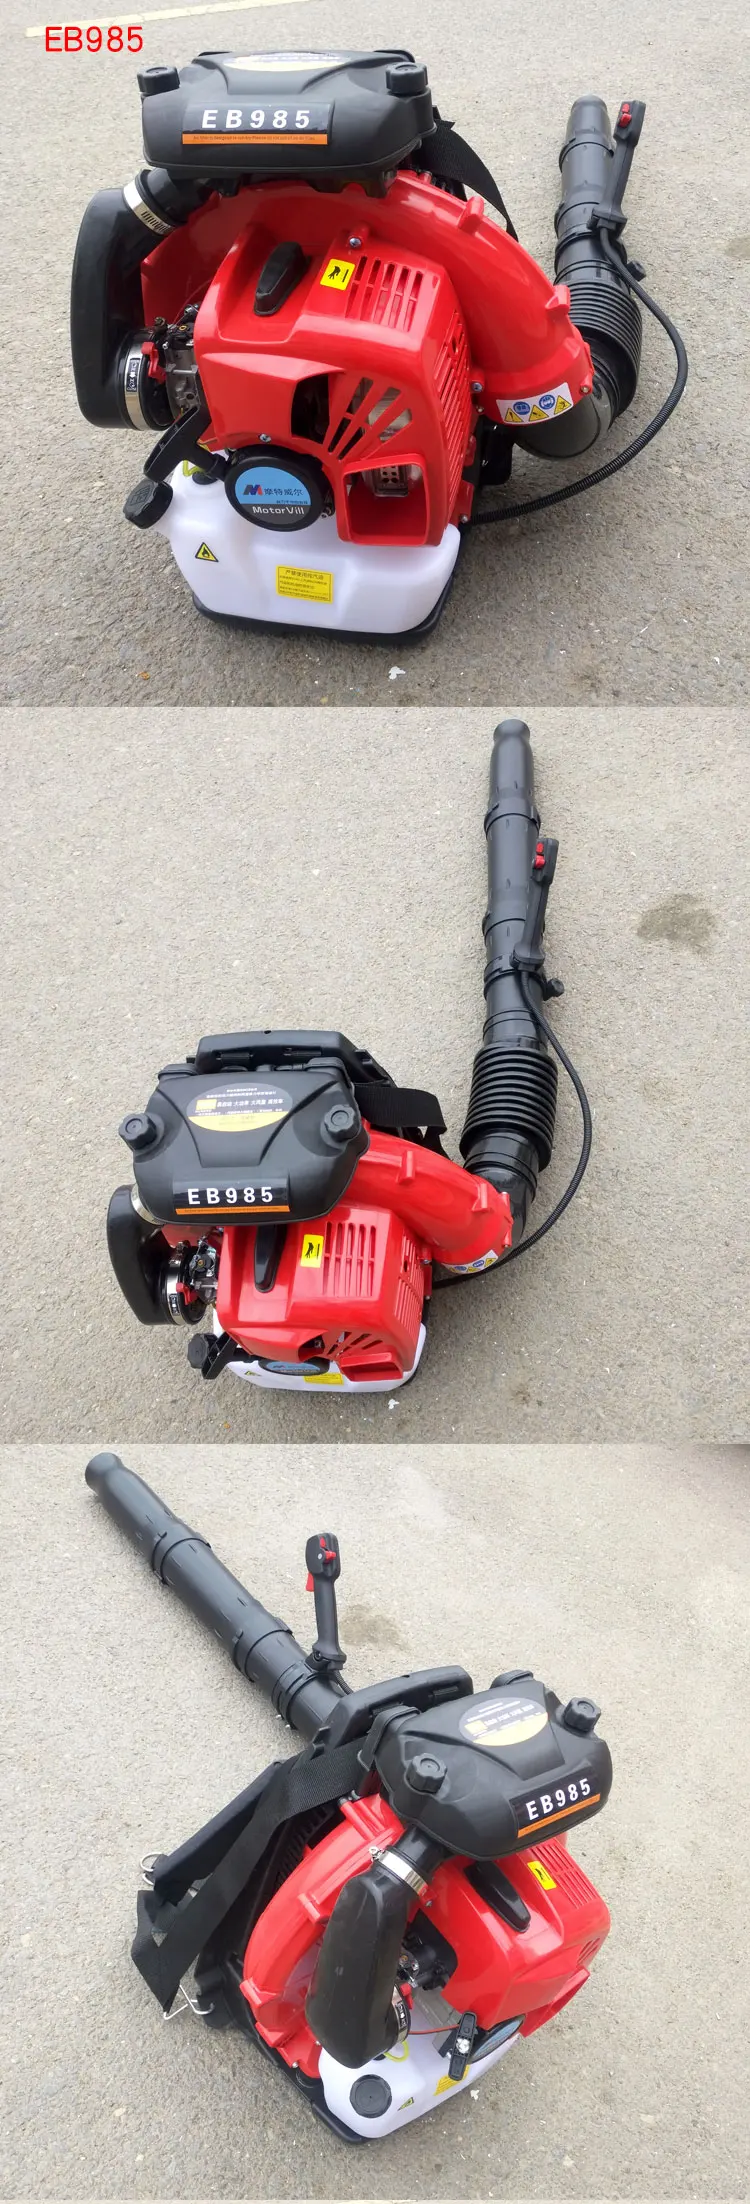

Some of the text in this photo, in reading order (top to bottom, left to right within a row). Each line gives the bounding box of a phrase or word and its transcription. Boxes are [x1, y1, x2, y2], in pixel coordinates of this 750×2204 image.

[201, 109, 310, 129] EB985
[252, 506, 305, 515] MotorVill
[187, 1186, 273, 1205] EB985
[525, 1778, 591, 1820] EB985
